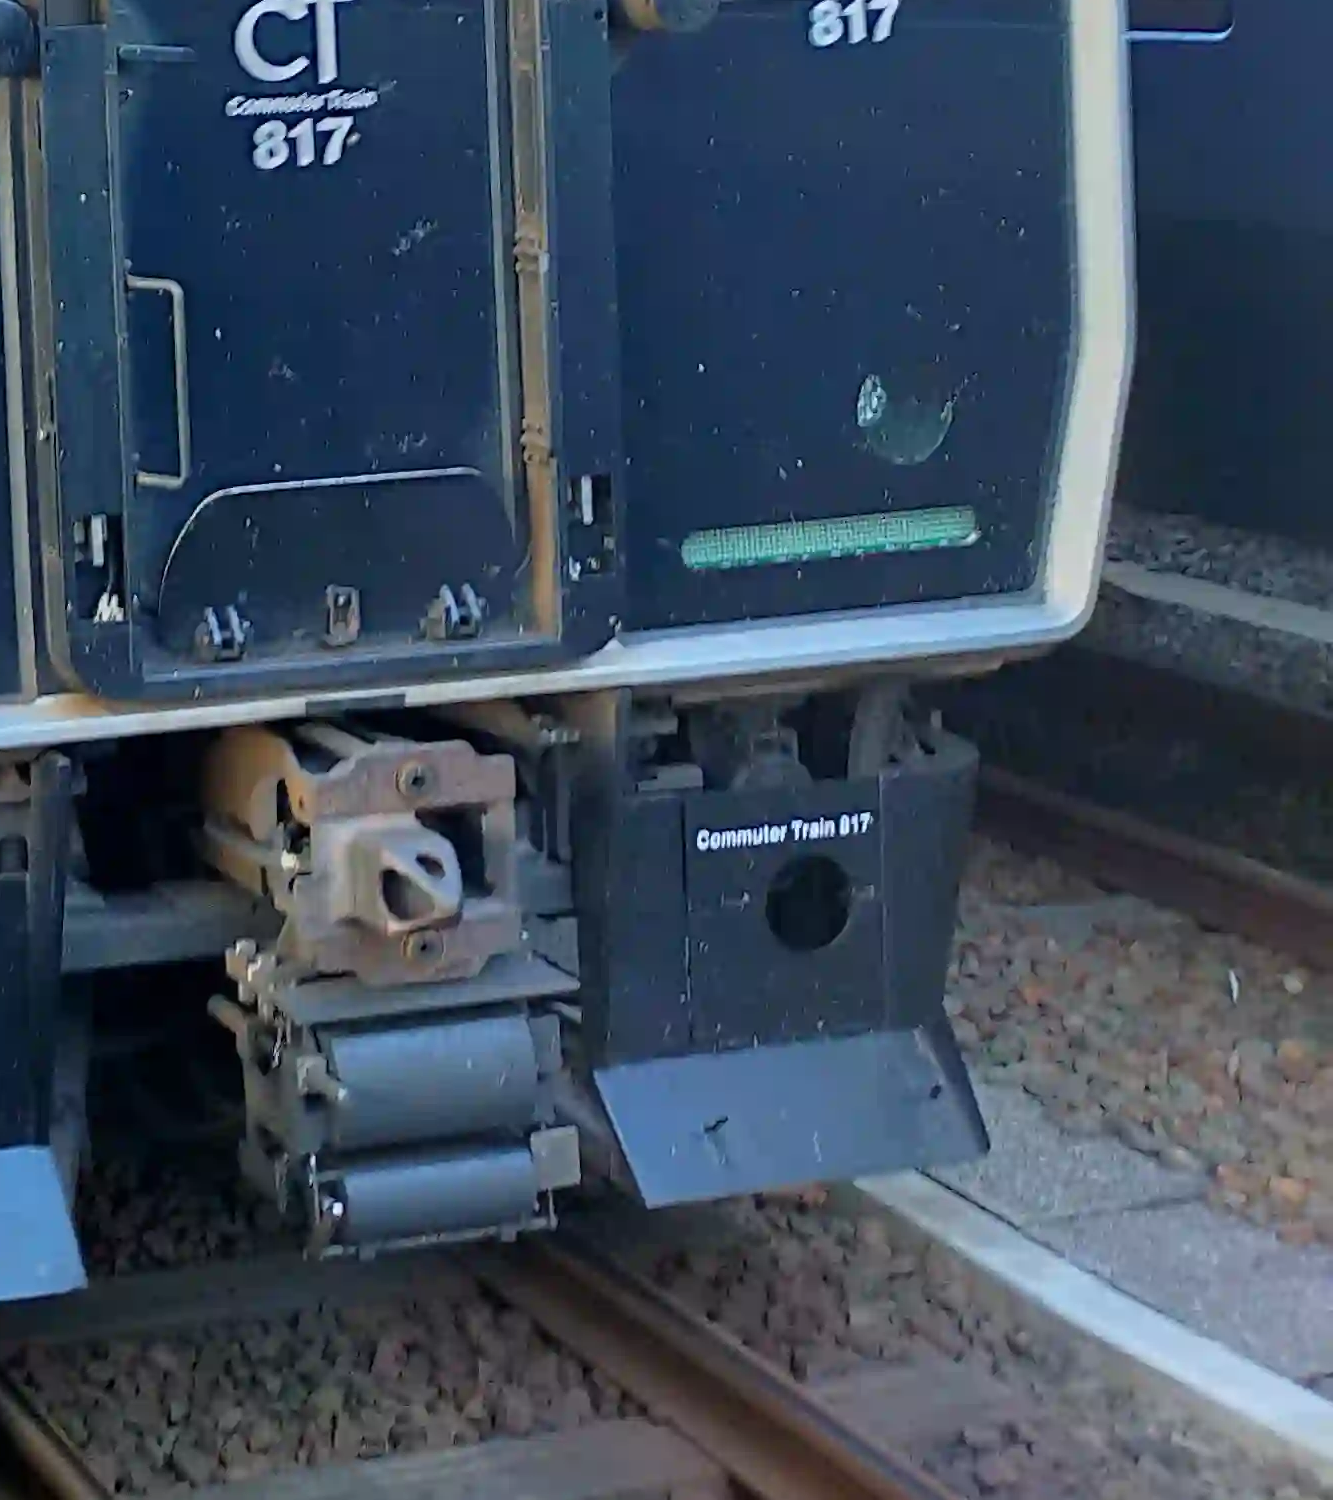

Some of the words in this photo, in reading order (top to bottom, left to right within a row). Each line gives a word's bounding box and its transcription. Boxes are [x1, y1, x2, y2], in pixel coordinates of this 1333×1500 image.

[252, 115, 355, 171] 817
[696, 822, 788, 851] Commuter
[791, 817, 836, 842] Train
[839, 811, 873, 837] 817
